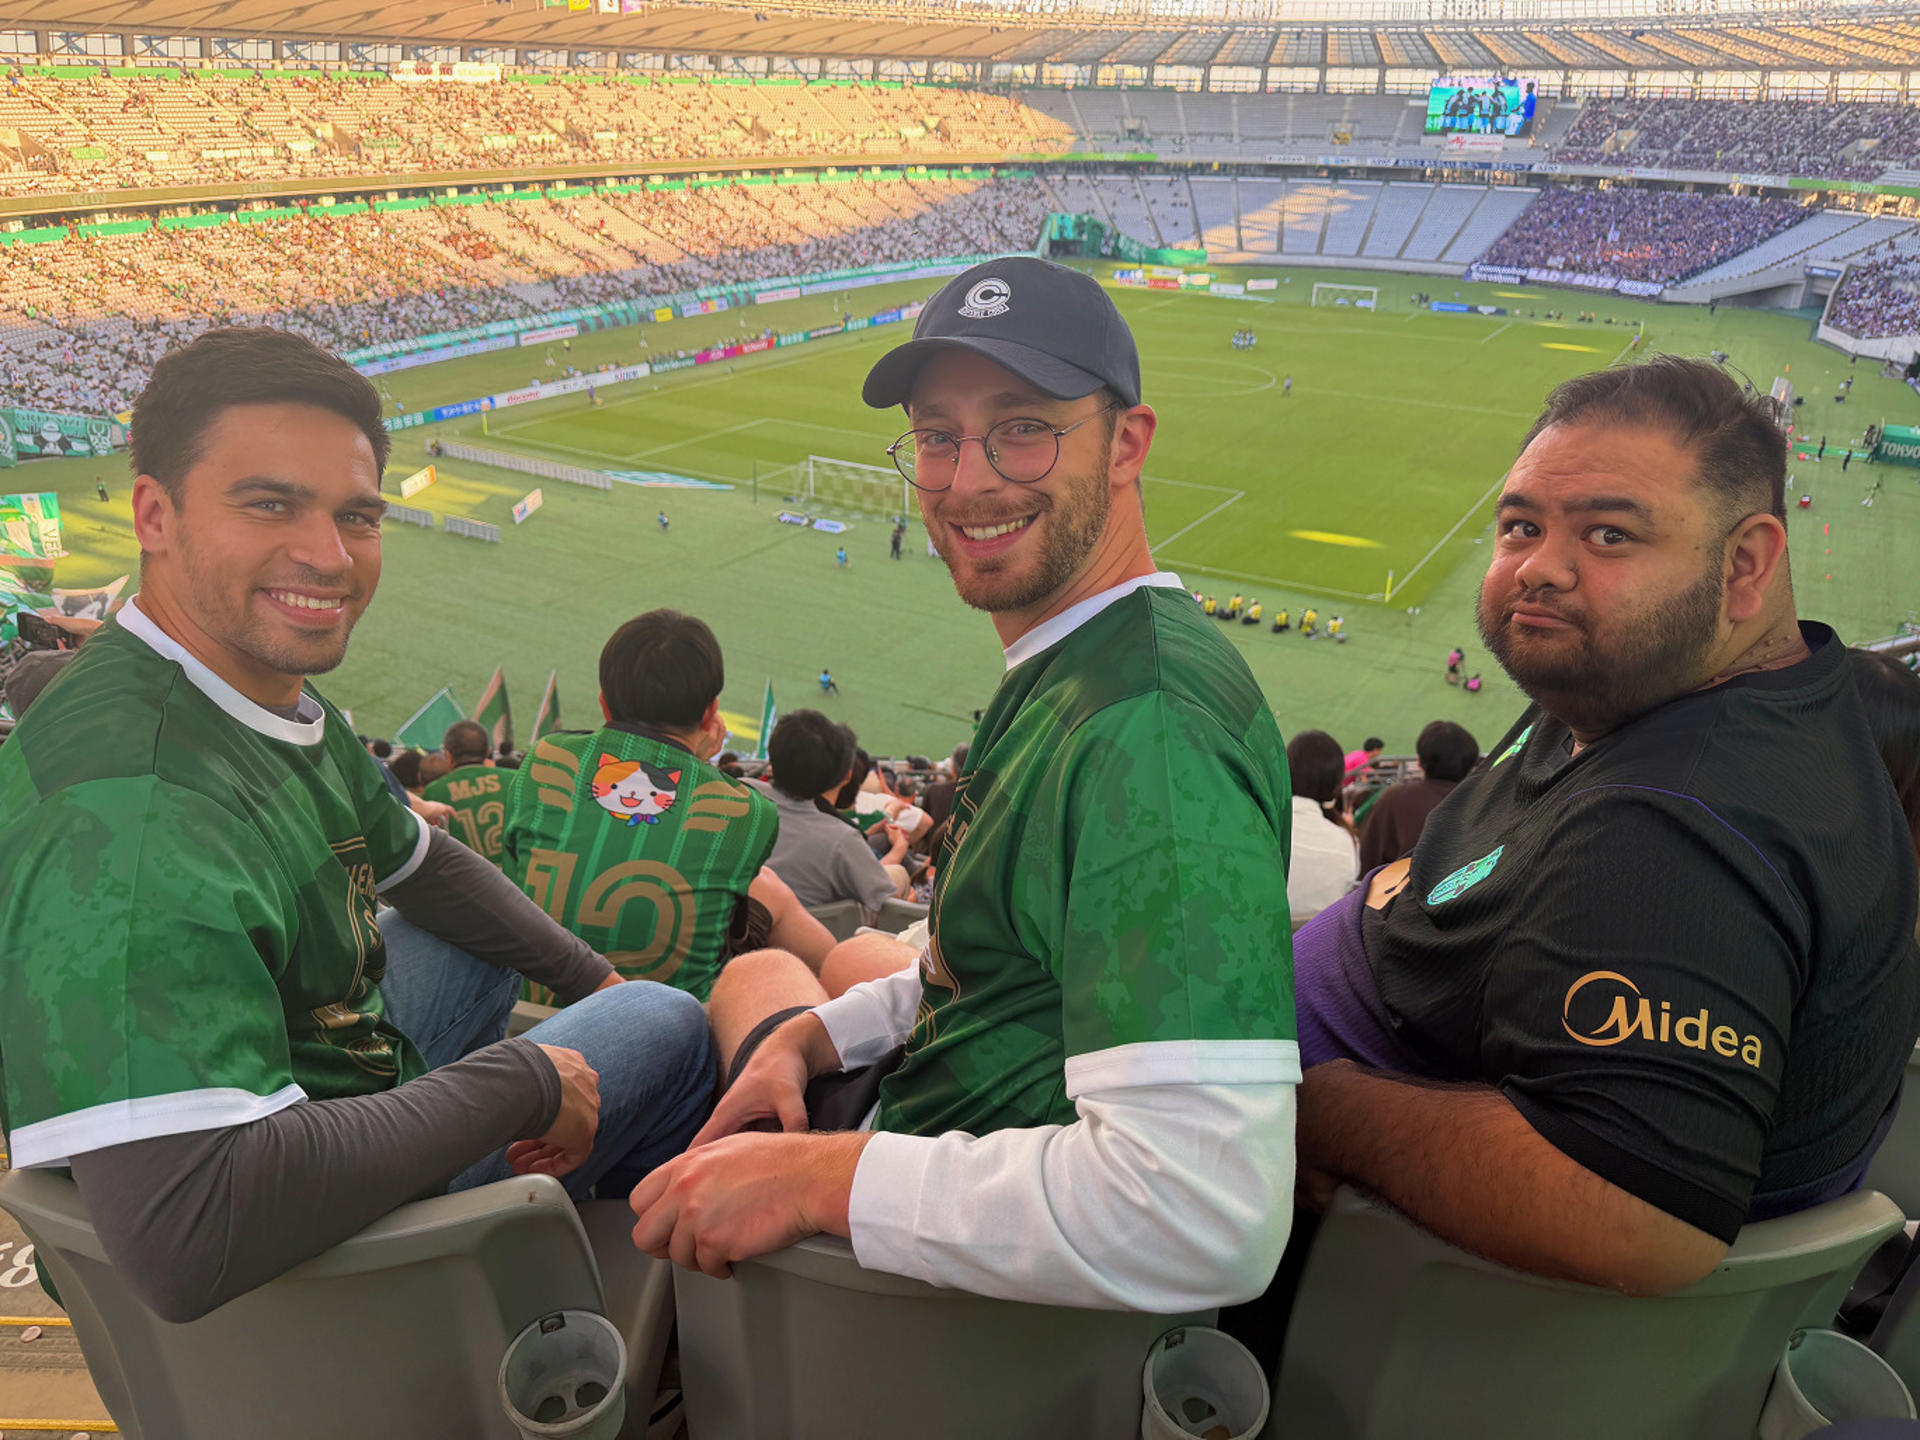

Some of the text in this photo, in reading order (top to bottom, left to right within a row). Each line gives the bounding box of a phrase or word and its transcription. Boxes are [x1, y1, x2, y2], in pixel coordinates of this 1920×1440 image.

[448, 774, 501, 801] MJS
[455, 801, 504, 857] 12
[1561, 970, 1763, 1069] Midea
